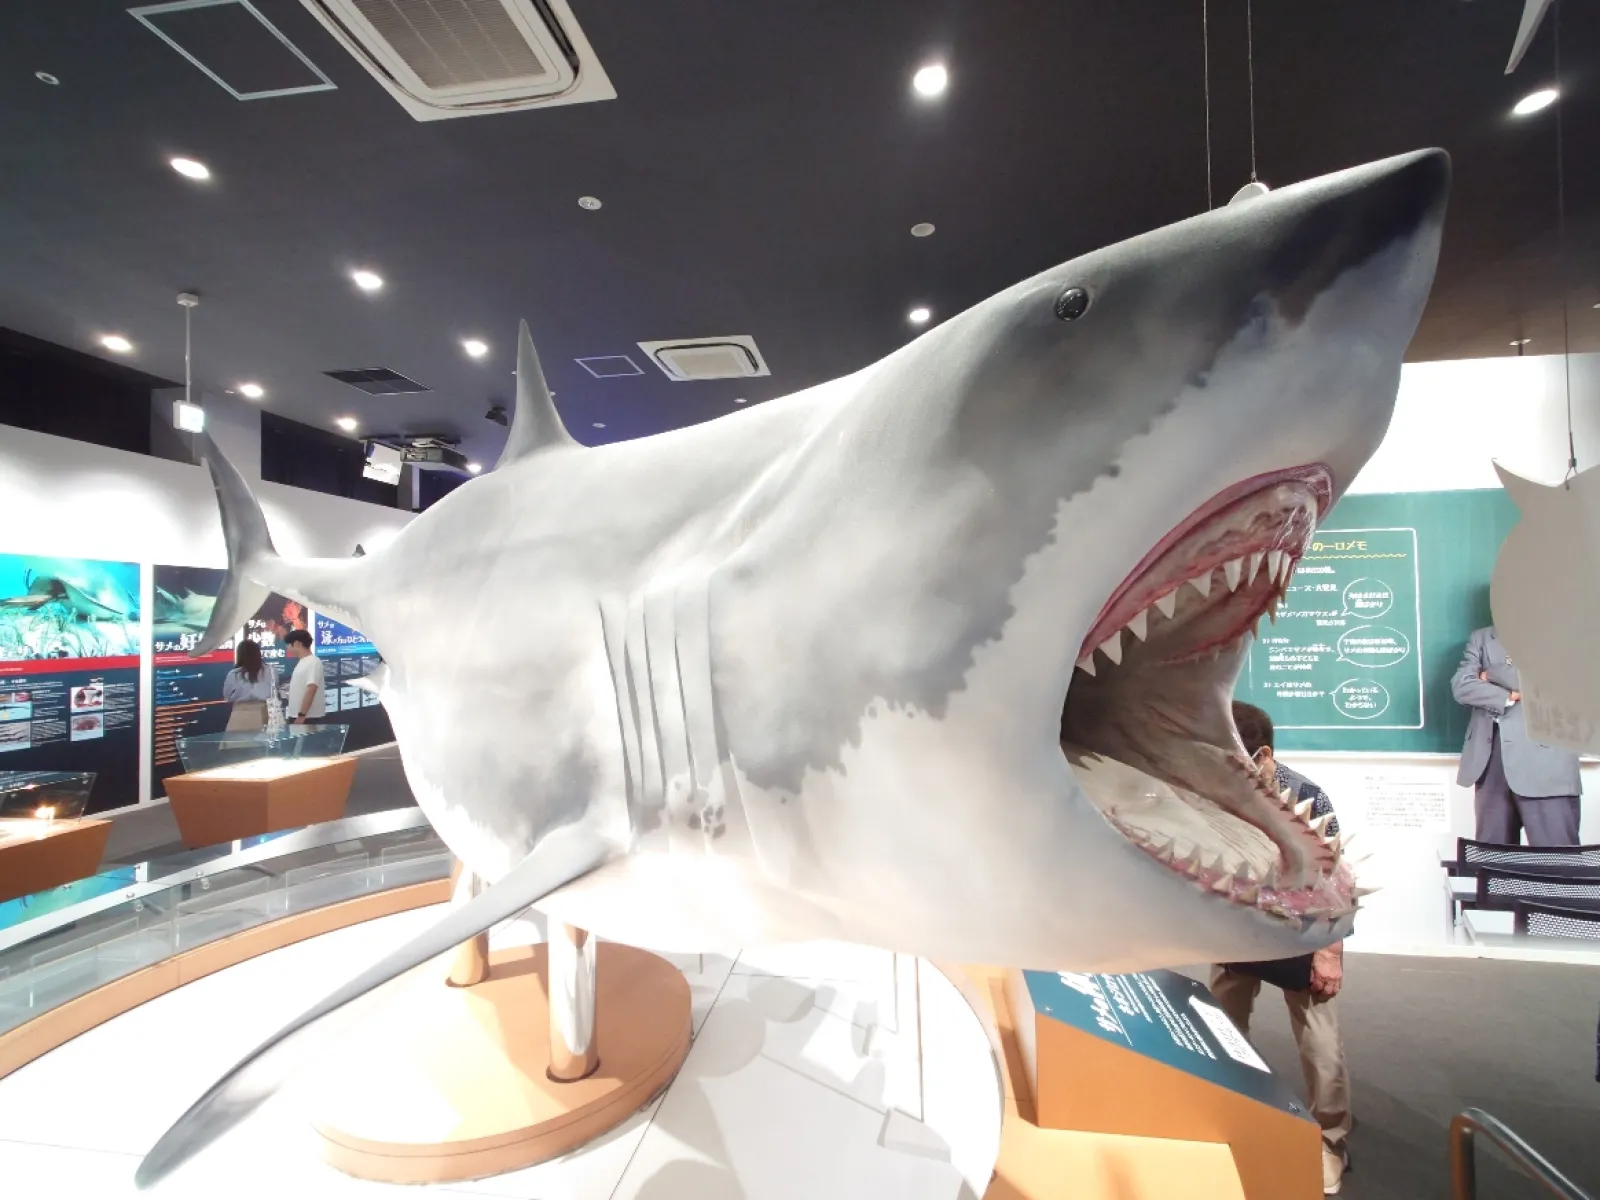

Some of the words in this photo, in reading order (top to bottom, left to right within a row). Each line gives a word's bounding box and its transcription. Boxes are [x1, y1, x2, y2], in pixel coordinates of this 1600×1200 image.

[1310, 541, 1368, 552] の一口メモ
